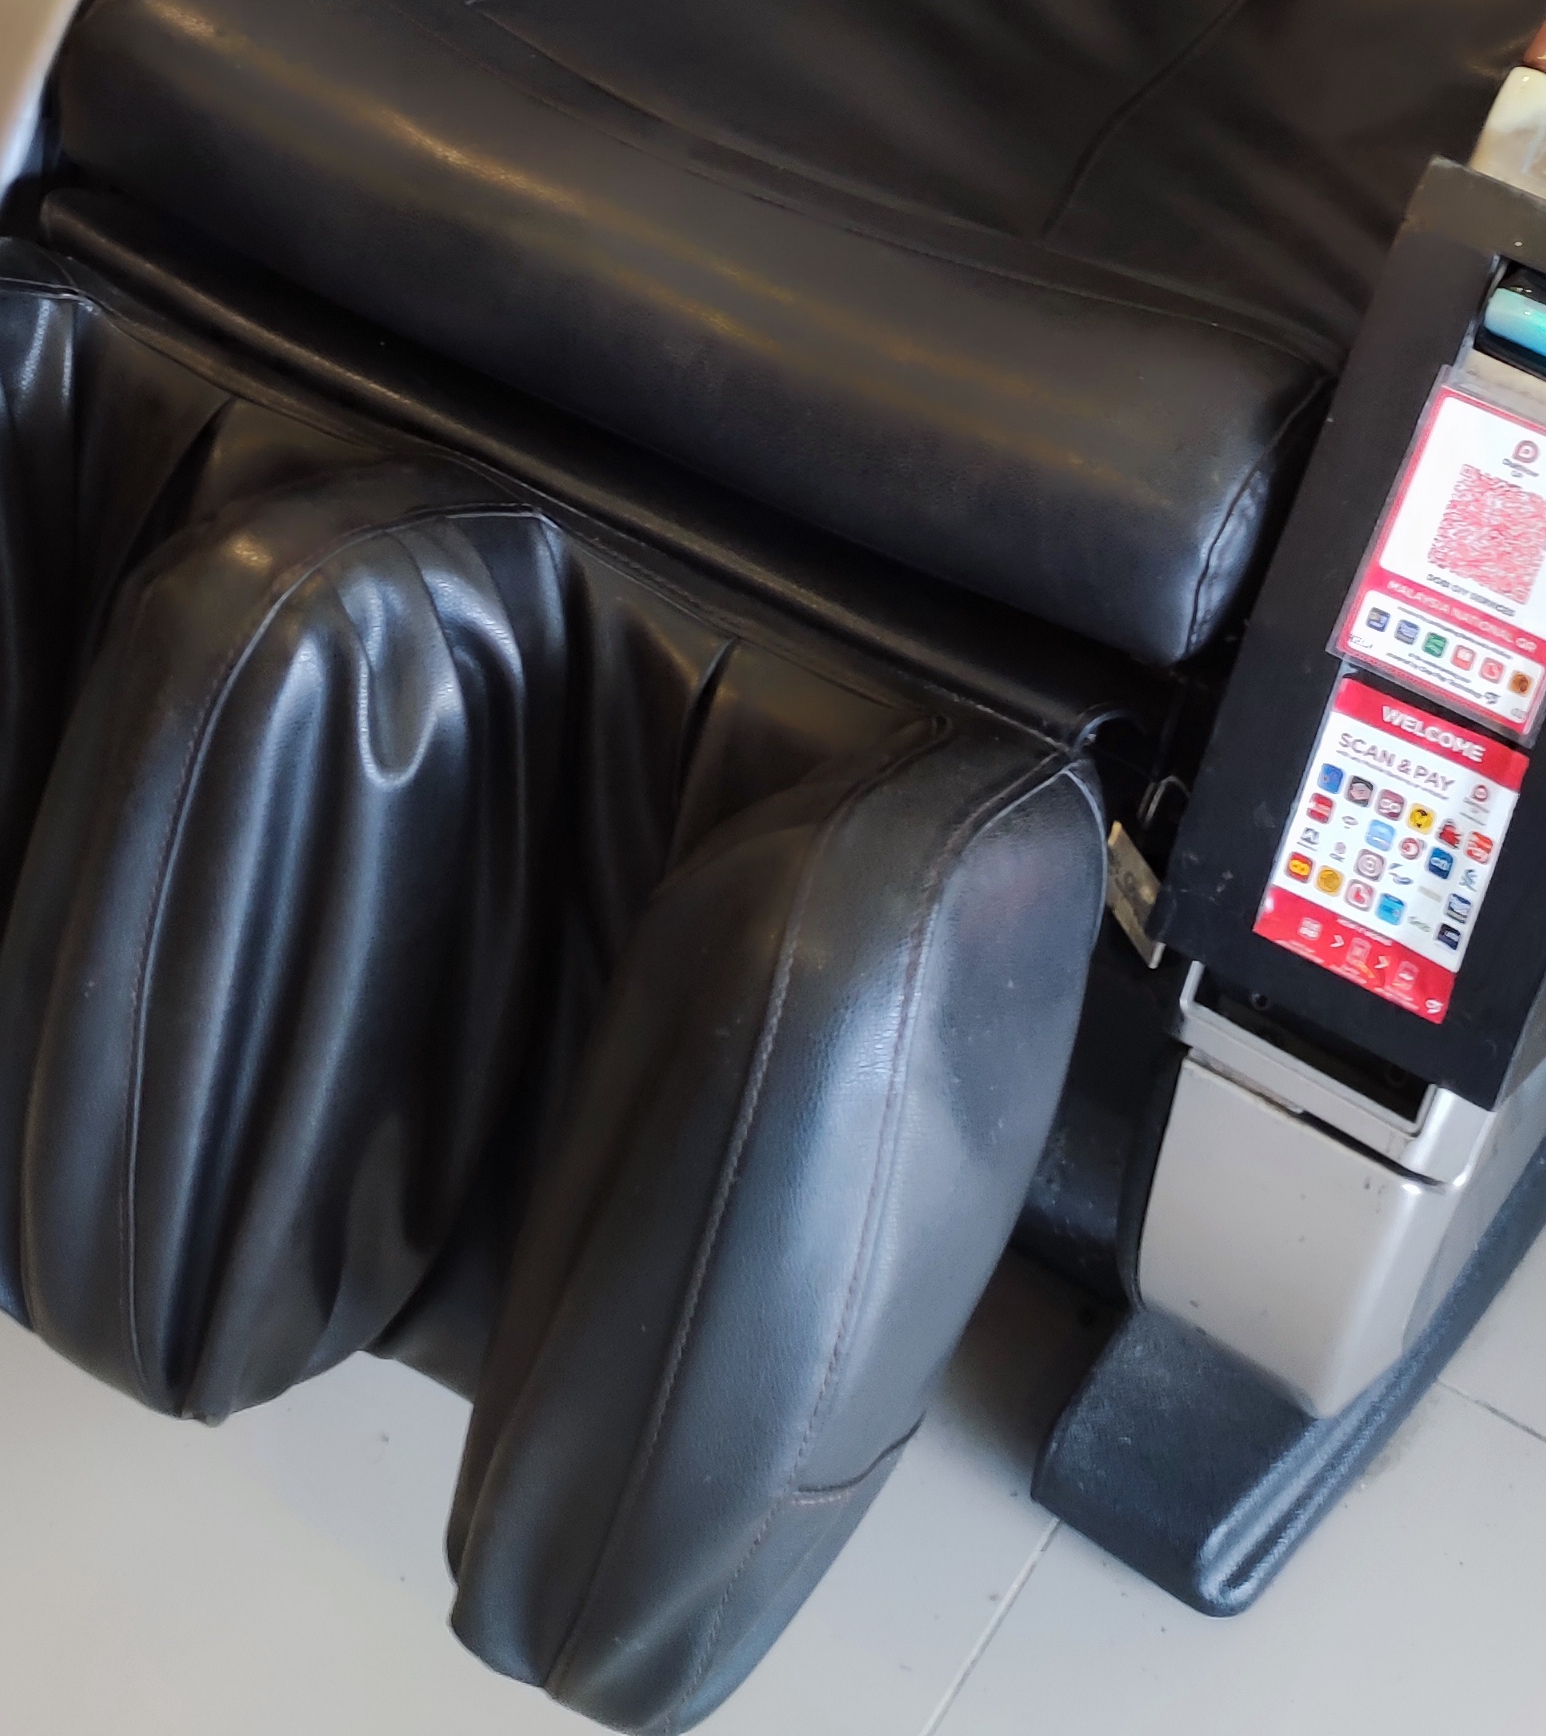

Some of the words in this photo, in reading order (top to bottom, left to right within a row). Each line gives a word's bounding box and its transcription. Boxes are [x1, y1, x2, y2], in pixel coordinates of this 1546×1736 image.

[1337, 732, 1395, 769] SCAN
[1399, 758, 1413, 775] &
[1414, 763, 1456, 793] PAY
[1382, 705, 1487, 764] WELCOME
